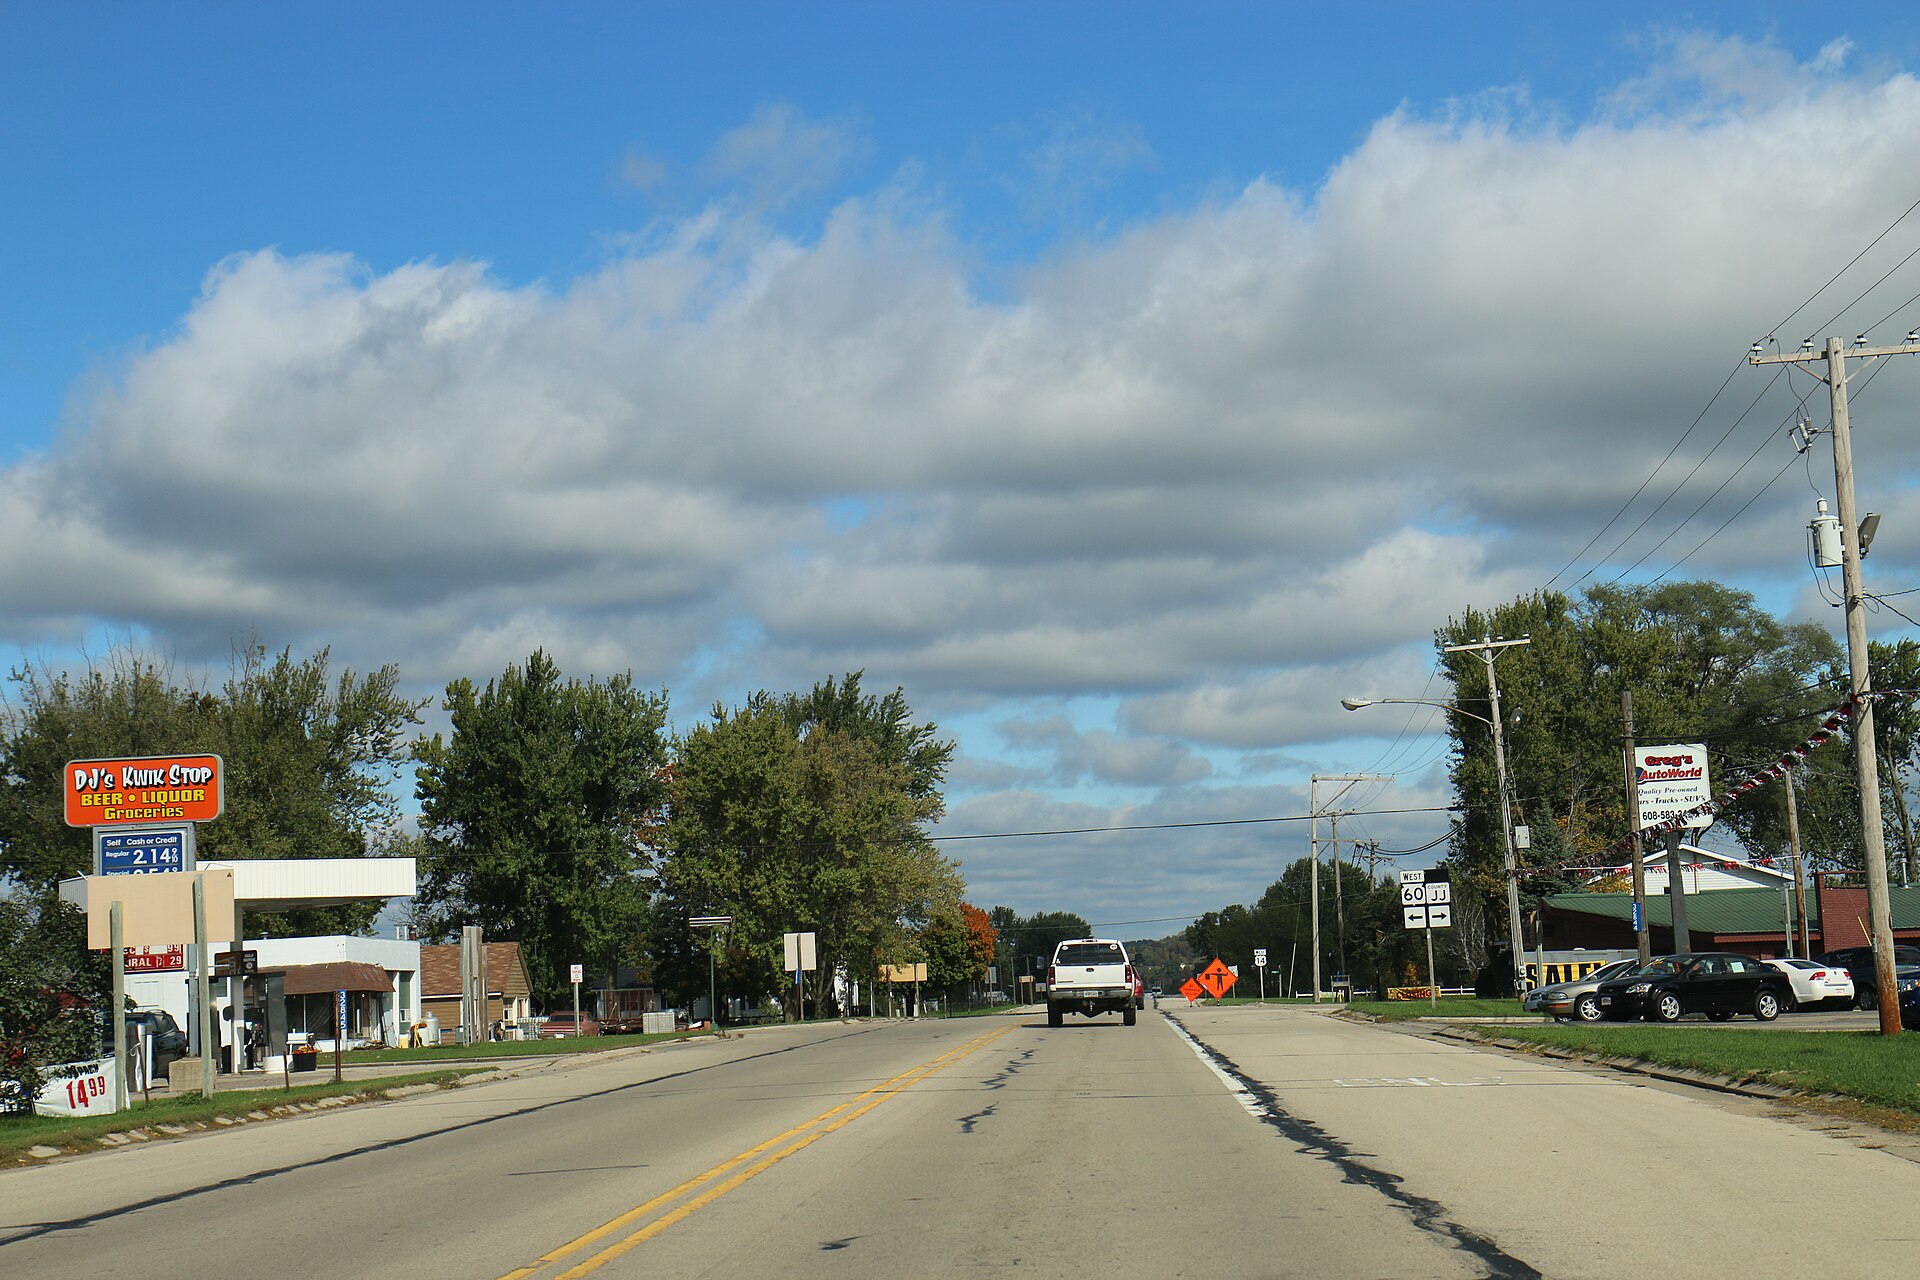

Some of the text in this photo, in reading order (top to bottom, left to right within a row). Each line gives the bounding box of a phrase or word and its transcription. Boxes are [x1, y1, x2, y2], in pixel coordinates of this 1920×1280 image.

[1645, 755, 1693, 767] Greg's
[74, 764, 213, 791] DJ's KWIK STOP
[1639, 767, 1702, 780] AutoWorld
[81, 789, 205, 806] BEER LIQUOR
[1638, 788, 1662, 796] Quality
[104, 805, 184, 819] Groceries
[155, 836, 178, 844] Credit
[1404, 888, 1423, 901] 60
[1431, 890, 1446, 901] JJ
[170, 956, 181, 965] 29
